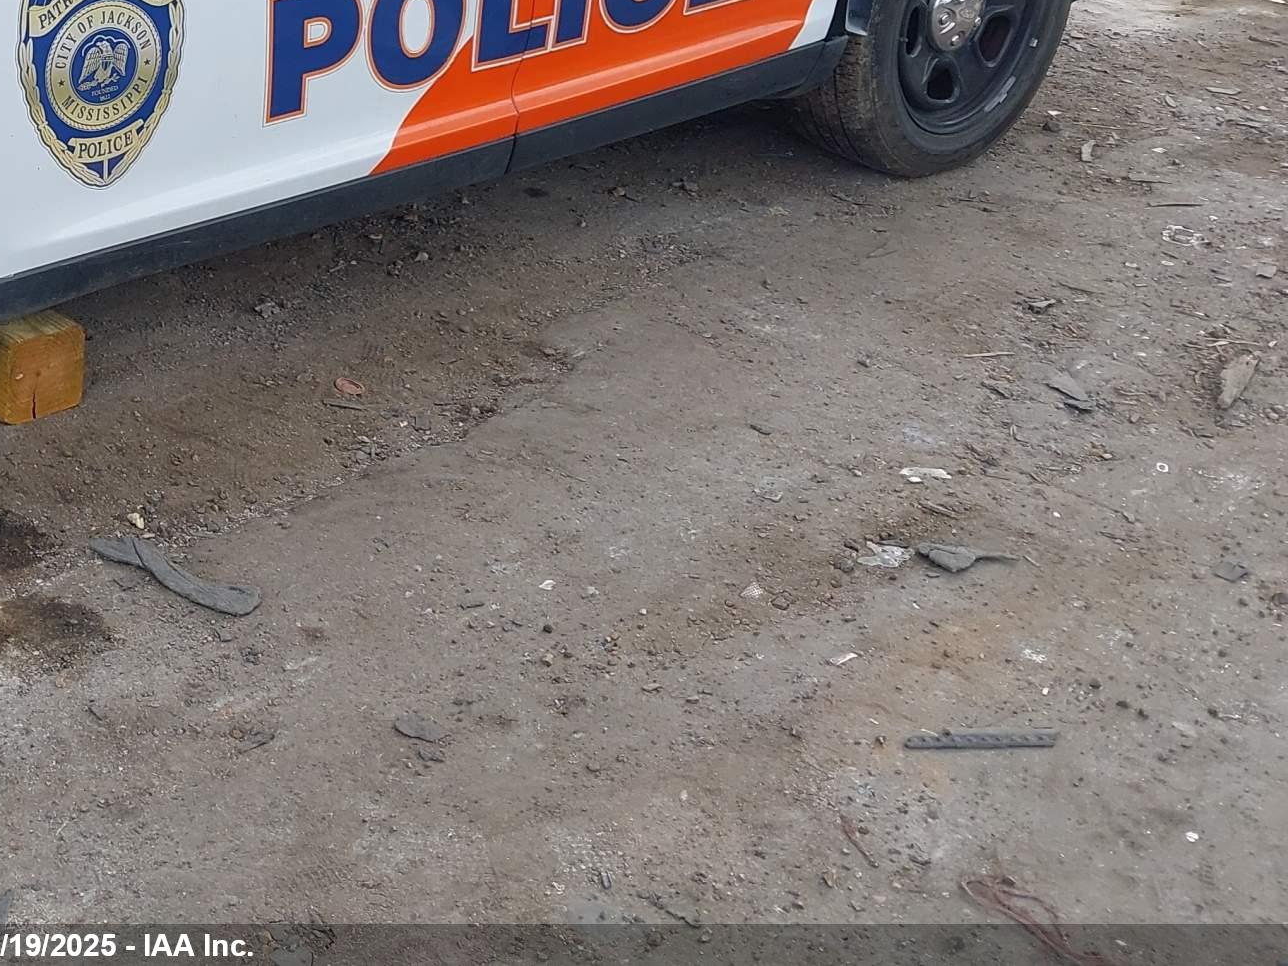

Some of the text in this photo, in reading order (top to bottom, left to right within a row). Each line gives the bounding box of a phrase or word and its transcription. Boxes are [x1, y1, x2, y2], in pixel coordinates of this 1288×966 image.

[55, 10, 152, 70] CITY OF JACKSON
[62, 76, 149, 122] MISSISSIPPI
[78, 130, 134, 159] POLICE
